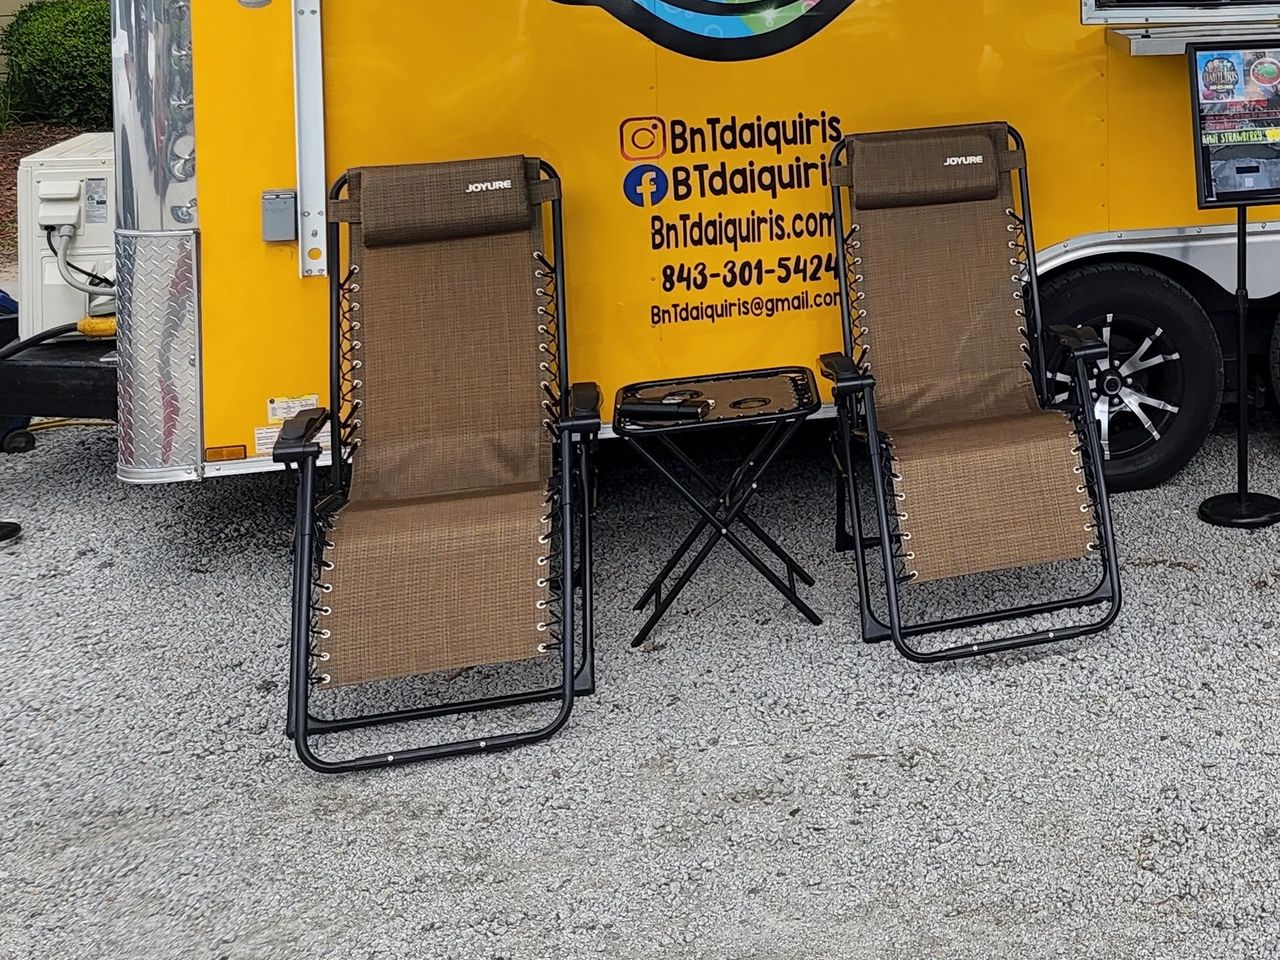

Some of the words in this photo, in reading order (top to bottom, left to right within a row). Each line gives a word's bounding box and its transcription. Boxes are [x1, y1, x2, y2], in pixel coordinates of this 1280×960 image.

[670, 110, 842, 154] BnTdaiquiris
[672, 153, 842, 201] BTdaiquiri
[944, 155, 983, 166] JOYURE
[465, 180, 512, 193] JOYURE
[661, 252, 840, 292] 843-301-5424
